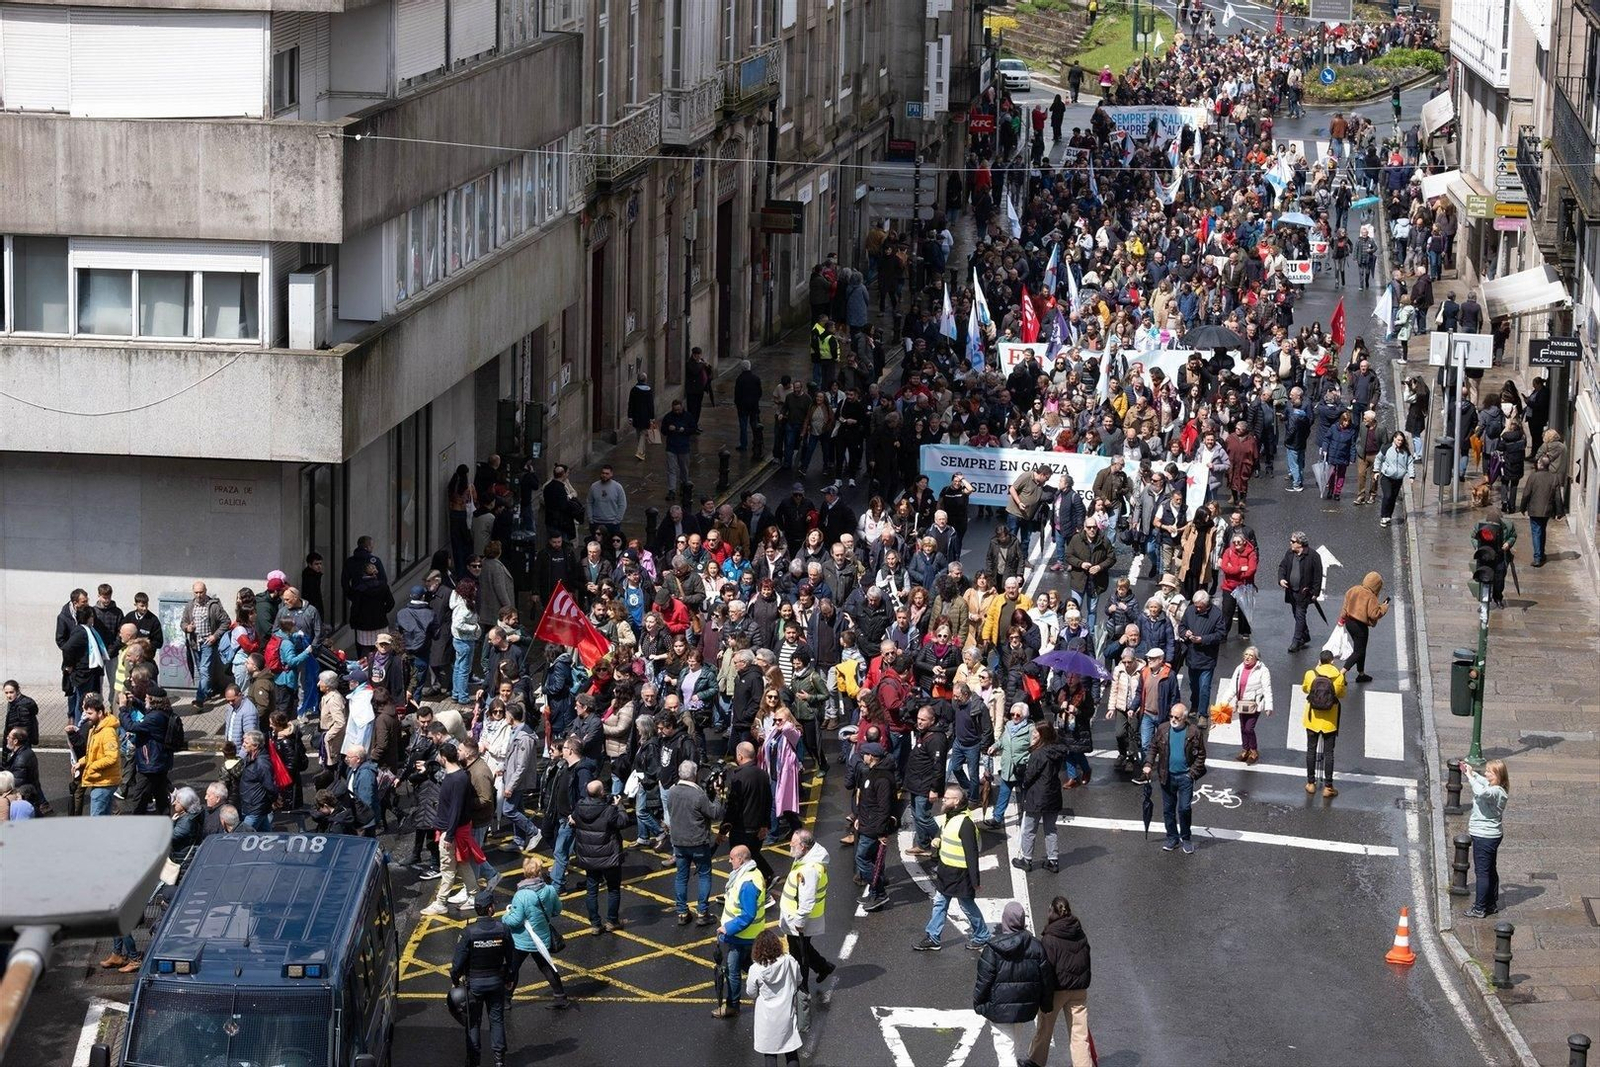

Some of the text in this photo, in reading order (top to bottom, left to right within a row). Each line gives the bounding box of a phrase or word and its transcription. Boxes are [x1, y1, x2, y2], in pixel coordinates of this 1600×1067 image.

[1112, 113, 1146, 124] SEMPRE
[1162, 113, 1194, 125] GALIZA
[940, 455, 996, 470] SEMPRE
[1000, 460, 1018, 471] EN
[214, 485, 253, 494] PRAZA DE
[218, 498, 247, 506] GALICIA
[241, 835, 328, 853] 8U-20
